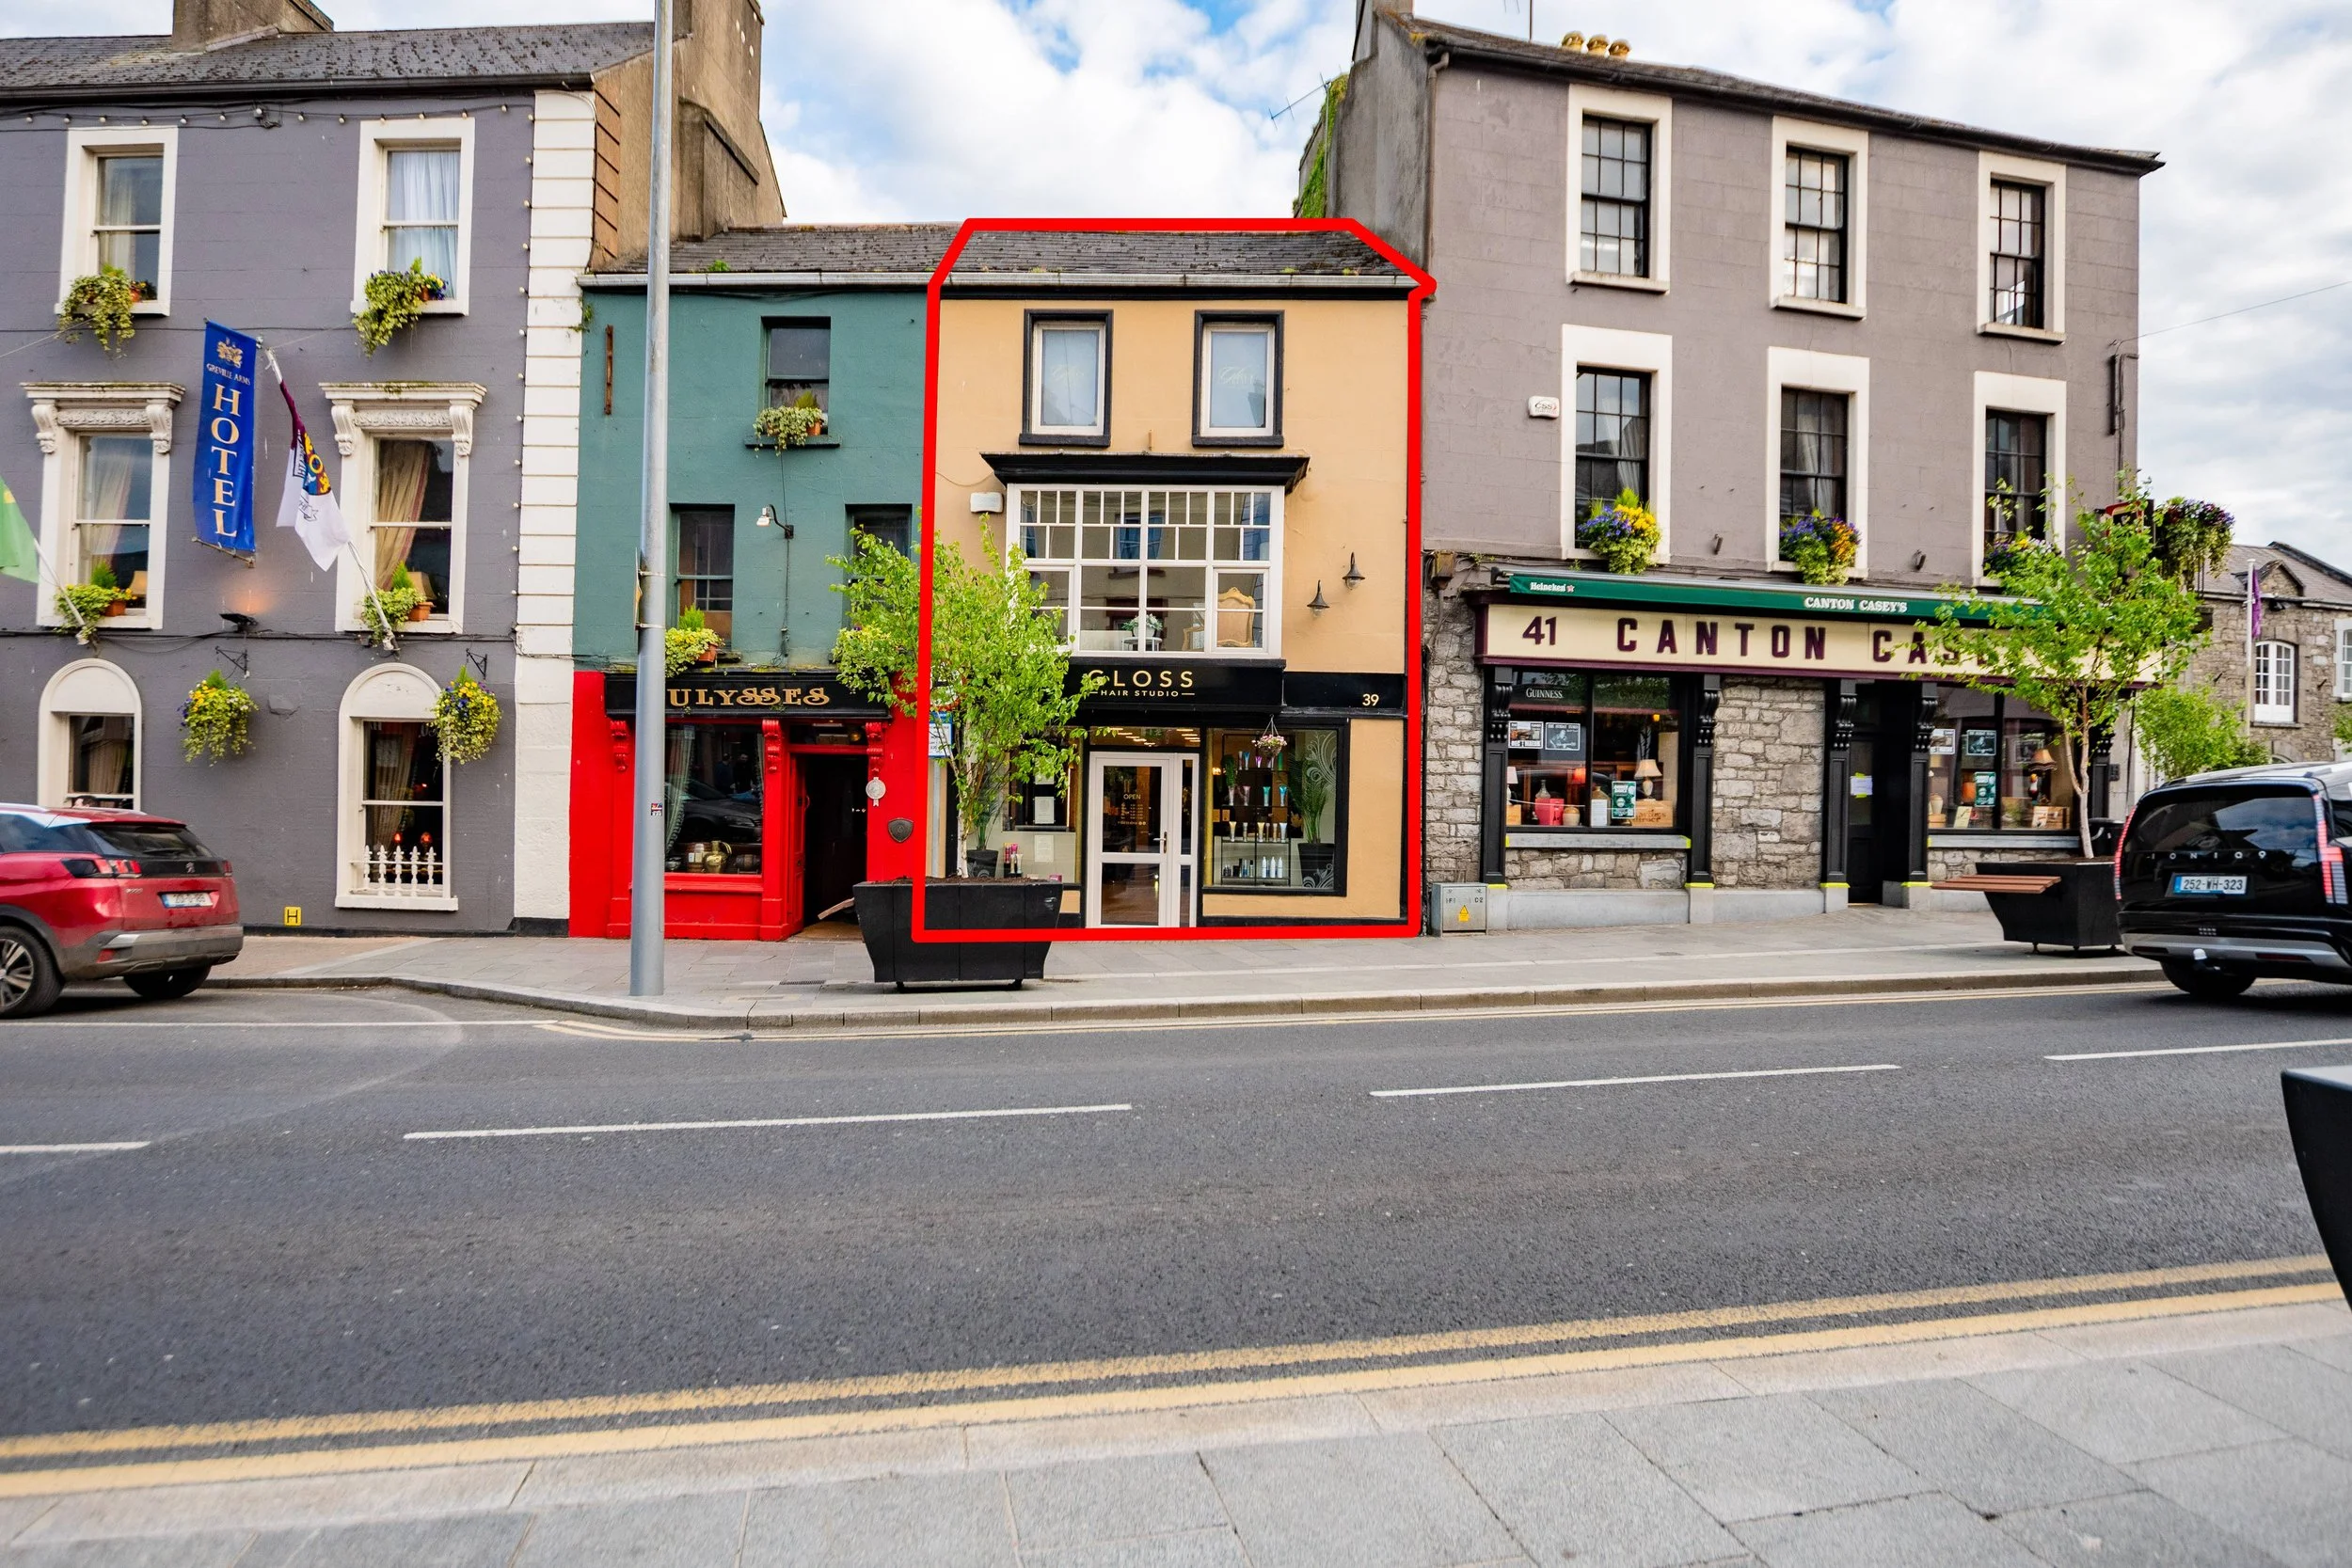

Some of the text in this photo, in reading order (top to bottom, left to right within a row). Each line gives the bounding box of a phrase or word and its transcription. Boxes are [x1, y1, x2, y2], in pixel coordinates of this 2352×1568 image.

[206, 363, 250, 386] GREVILLE ARMS
[211, 383, 242, 537] HOTEL
[1530, 582, 1566, 592] Heineken
[1804, 596, 1908, 613] CANTON CASEY'S
[1522, 616, 1557, 645] 41
[1617, 618, 1826, 660] CANTON
[667, 687, 830, 706] ULYSSES
[1362, 693, 1379, 706] 39
[1525, 688, 1564, 699] GUINNESS
[2183, 879, 2244, 891] 252-WH-323
[286, 909, 298, 924] H
